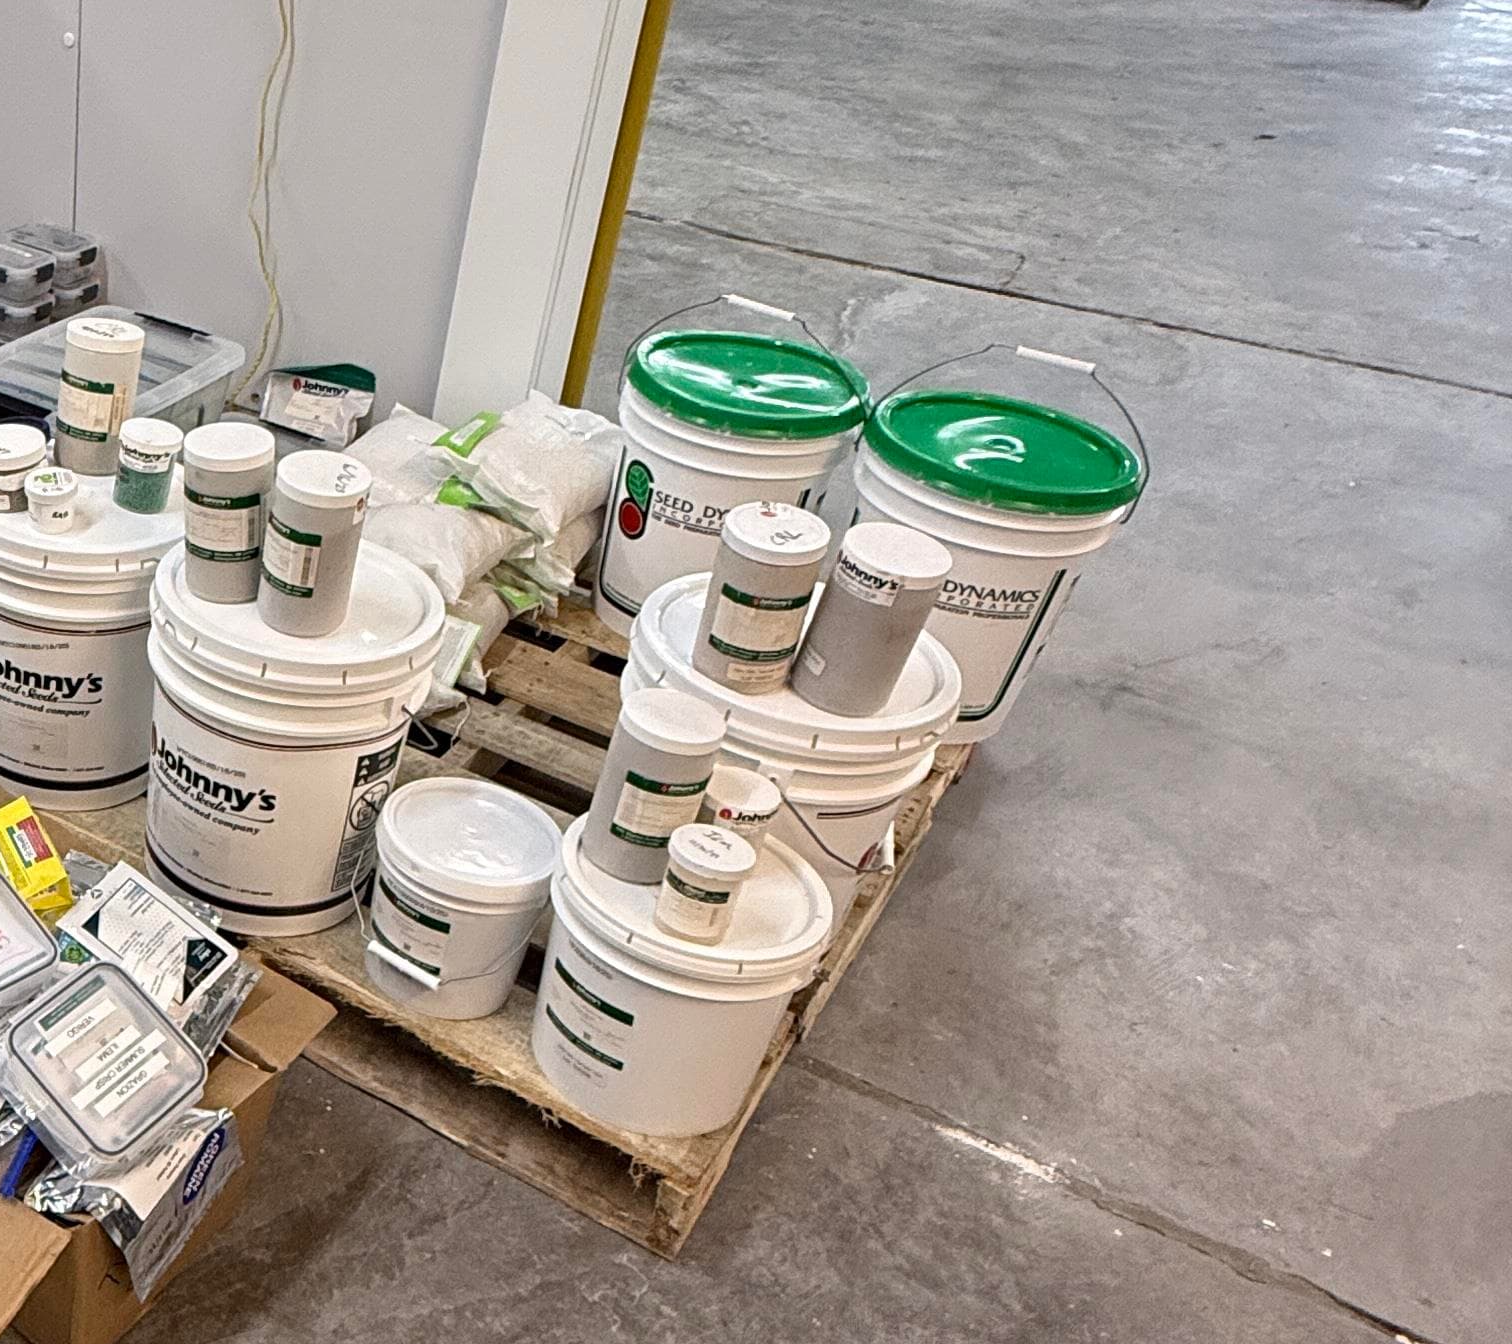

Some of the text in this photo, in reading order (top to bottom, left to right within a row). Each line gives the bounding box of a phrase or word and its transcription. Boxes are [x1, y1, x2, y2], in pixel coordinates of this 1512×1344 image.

[655, 491, 693, 514] SEED
[840, 555, 899, 591] Johnny's
[942, 579, 1041, 603] DYNAMICS
[157, 738, 276, 813] Johnny's
